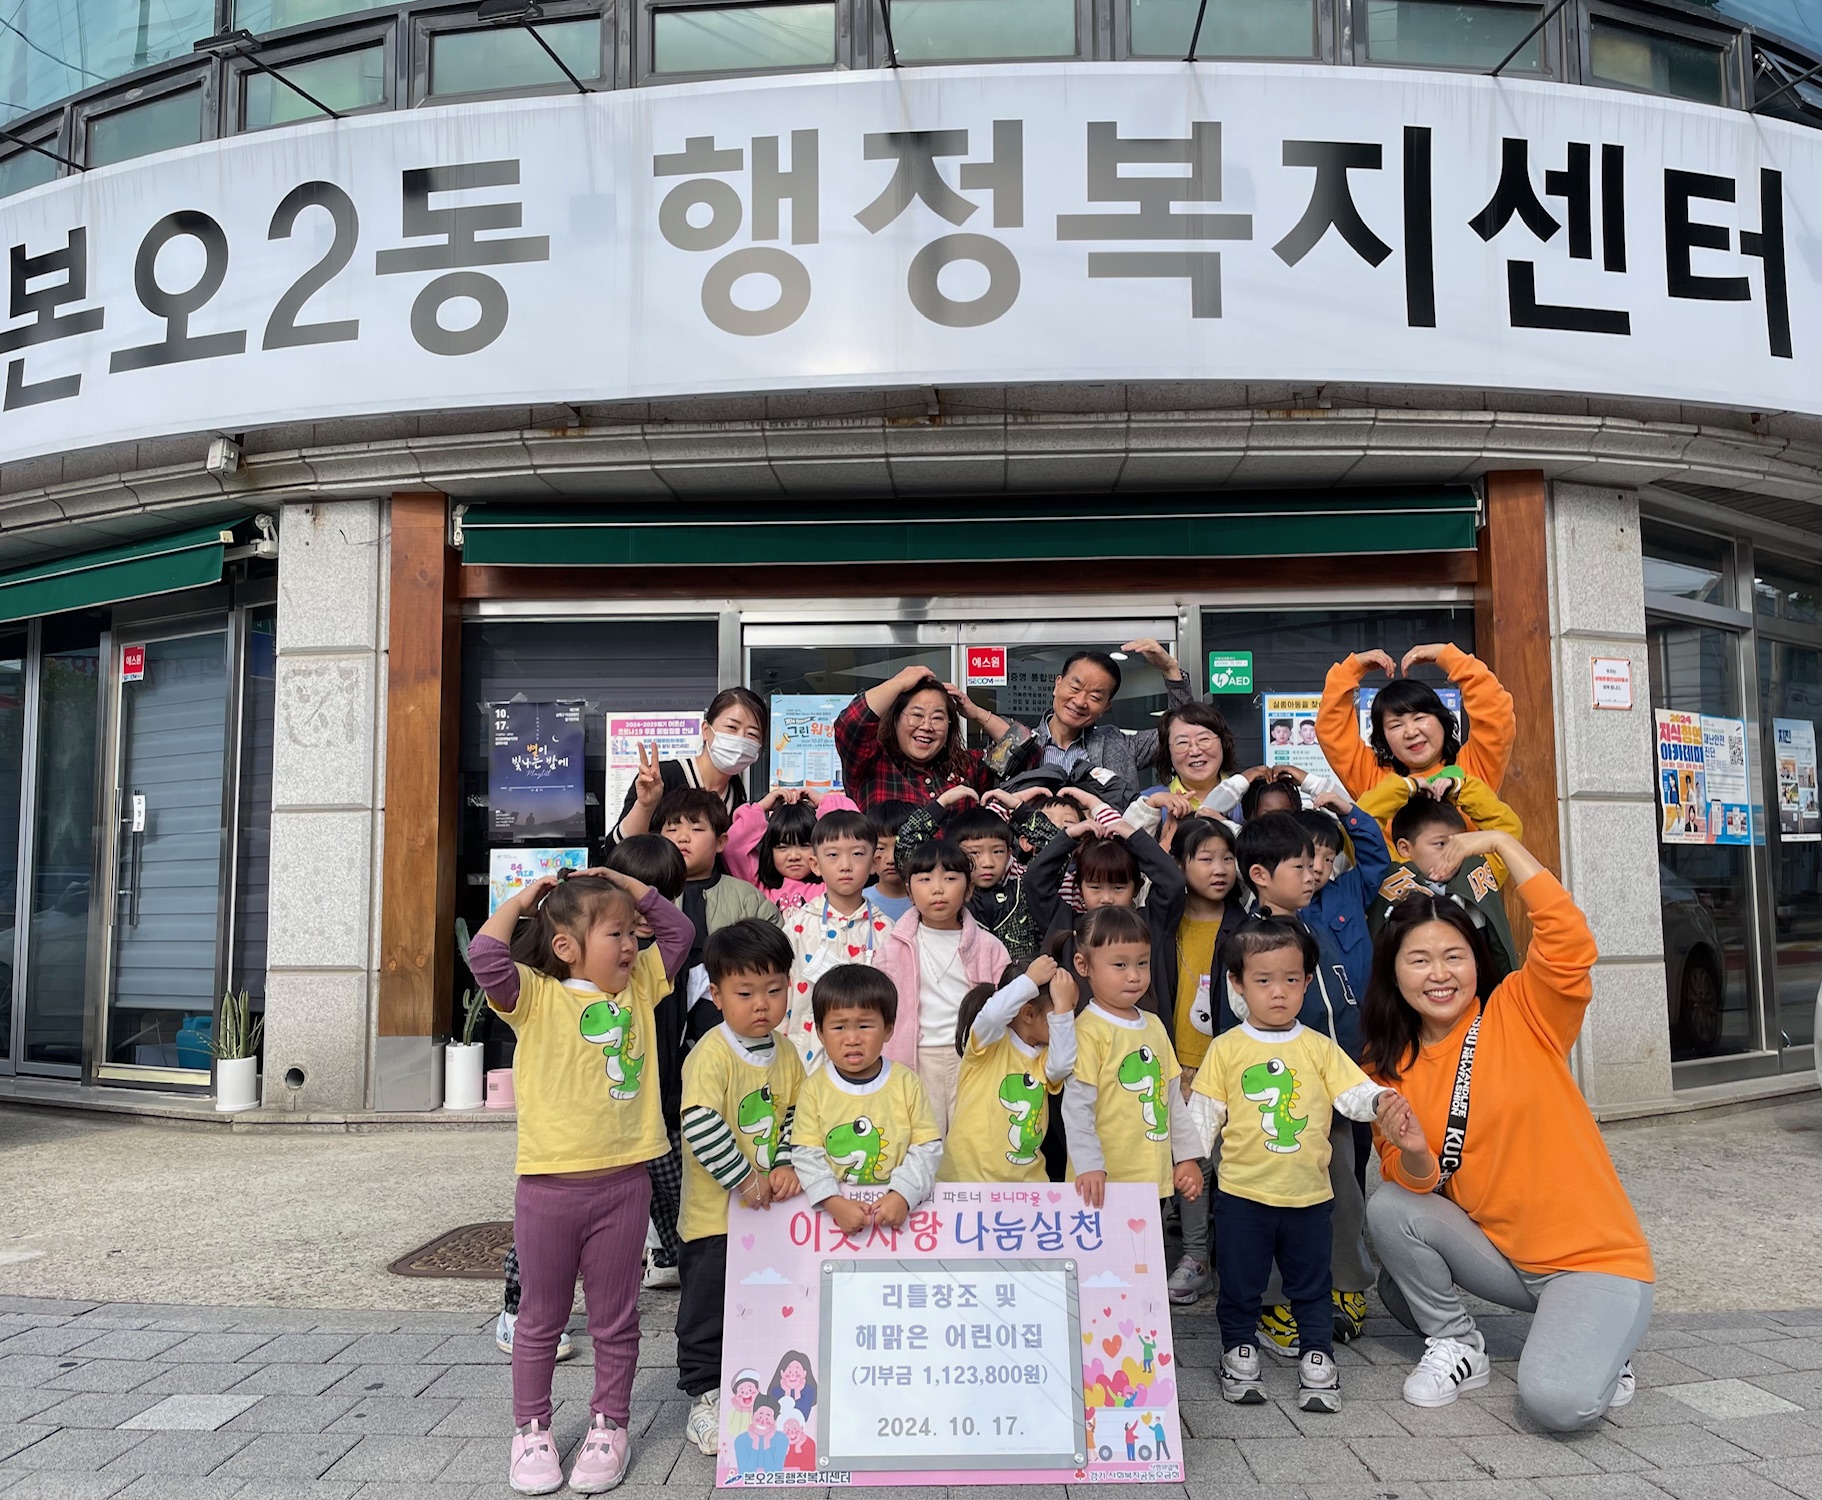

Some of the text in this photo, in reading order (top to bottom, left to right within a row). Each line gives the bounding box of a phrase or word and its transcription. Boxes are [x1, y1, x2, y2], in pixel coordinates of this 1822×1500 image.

[0, 120, 1793, 411] 본오2동 행정복지센터
[971, 656, 1000, 668] 에스원
[1228, 676, 1250, 686] AED
[495, 709, 510, 719] 10.
[1669, 714, 1691, 724] 2024
[494, 721, 509, 730] 17.
[787, 725, 810, 738] 그린
[526, 743, 547, 757] 별이
[1660, 743, 1704, 763] 아카데미
[511, 755, 569, 771] 빛나는 밤에
[943, 1191, 982, 1203] 파트너
[990, 1191, 1041, 1207] 보니마을
[954, 1209, 1104, 1252] 나눔실천
[882, 1283, 1017, 1309] 리틀창조 및
[855, 1323, 1043, 1350] 해맑은 어린이집
[851, 1363, 1048, 1387] (기부금 1,123,800원)
[877, 1415, 1025, 1437] 2024. 10. 17.
